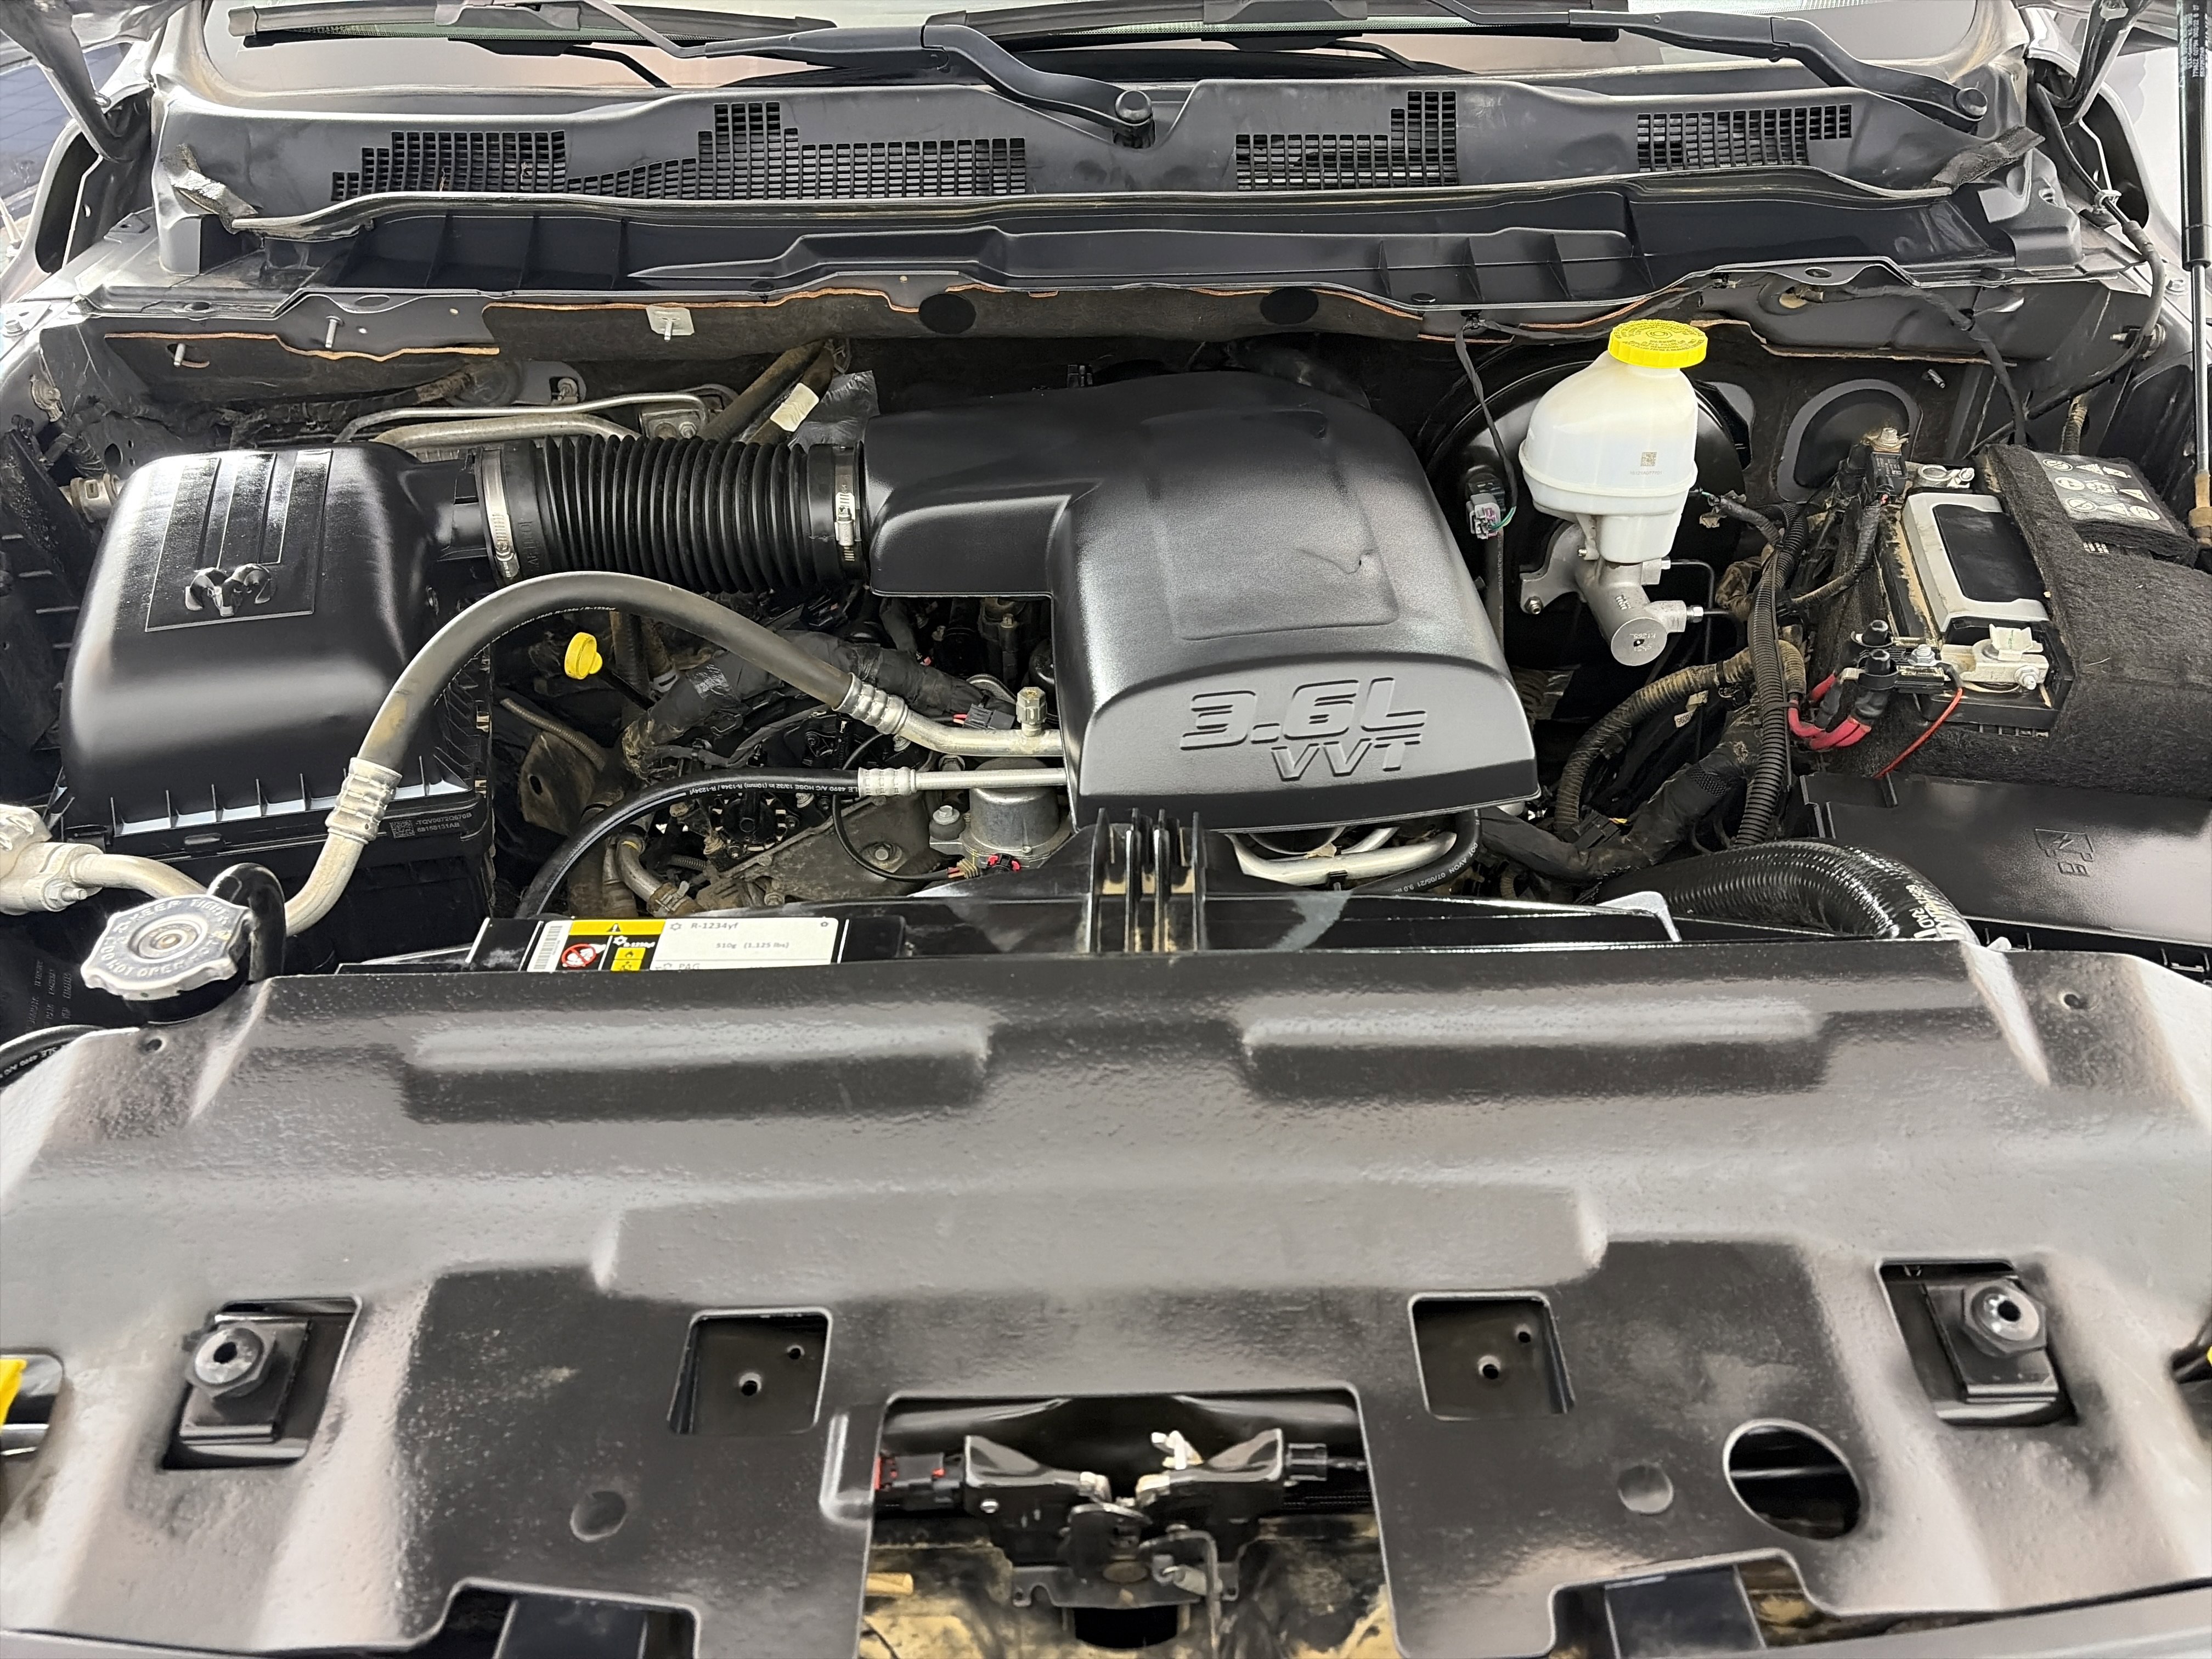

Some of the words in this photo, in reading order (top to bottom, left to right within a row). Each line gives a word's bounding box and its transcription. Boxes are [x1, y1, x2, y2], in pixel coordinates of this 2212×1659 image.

[1180, 677, 1426, 751] 3.6L
[1271, 733, 1422, 782] VVT
[1468, 842, 1479, 857] DOT
[1448, 857, 1468, 874] AVON
[1417, 873, 1446, 887] 07/05/21
[130, 900, 181, 922] KEEP
[1909, 907, 1935, 928] RAD
[691, 922, 739, 930] R-1234yf
[137, 960, 185, 977] OPEN
